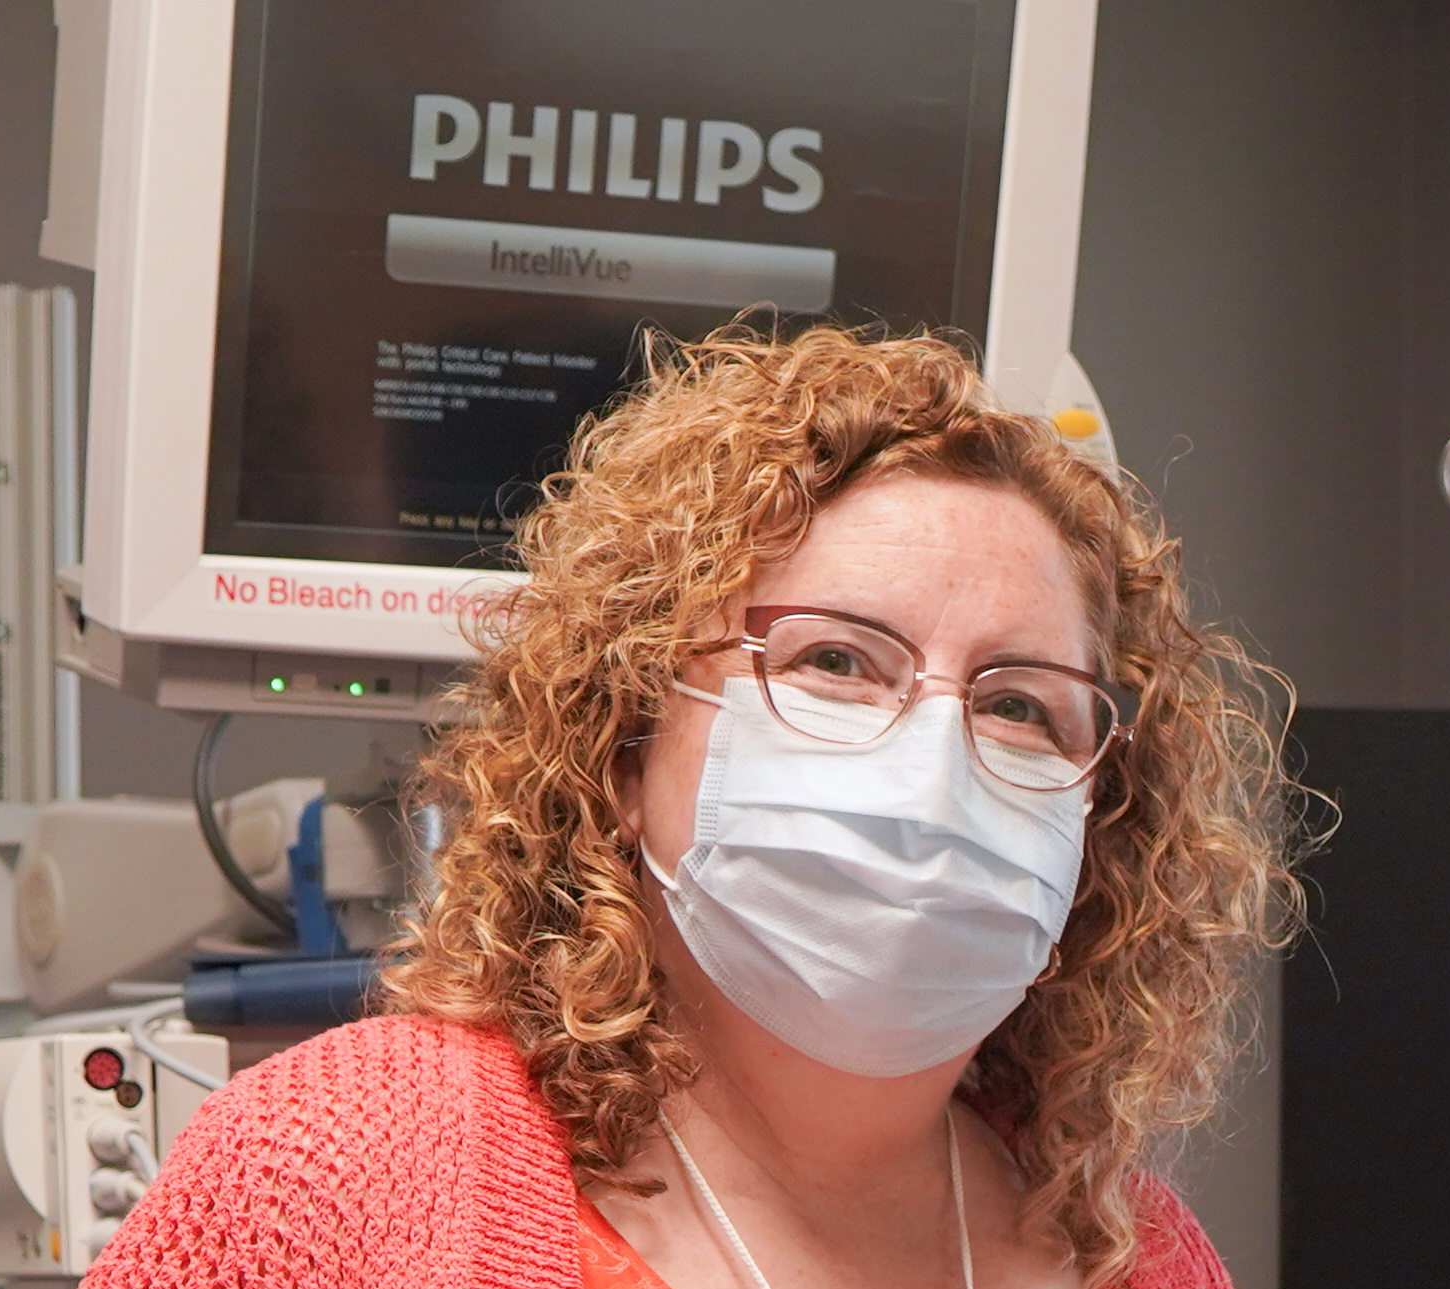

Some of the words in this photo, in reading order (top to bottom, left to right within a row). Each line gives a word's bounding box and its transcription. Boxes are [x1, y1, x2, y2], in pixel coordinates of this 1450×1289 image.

[409, 93, 825, 214] PHILIPS
[489, 240, 633, 284] IntelliVue
[215, 573, 257, 603] No
[267, 576, 372, 611] Bleach
[381, 589, 418, 613] on
